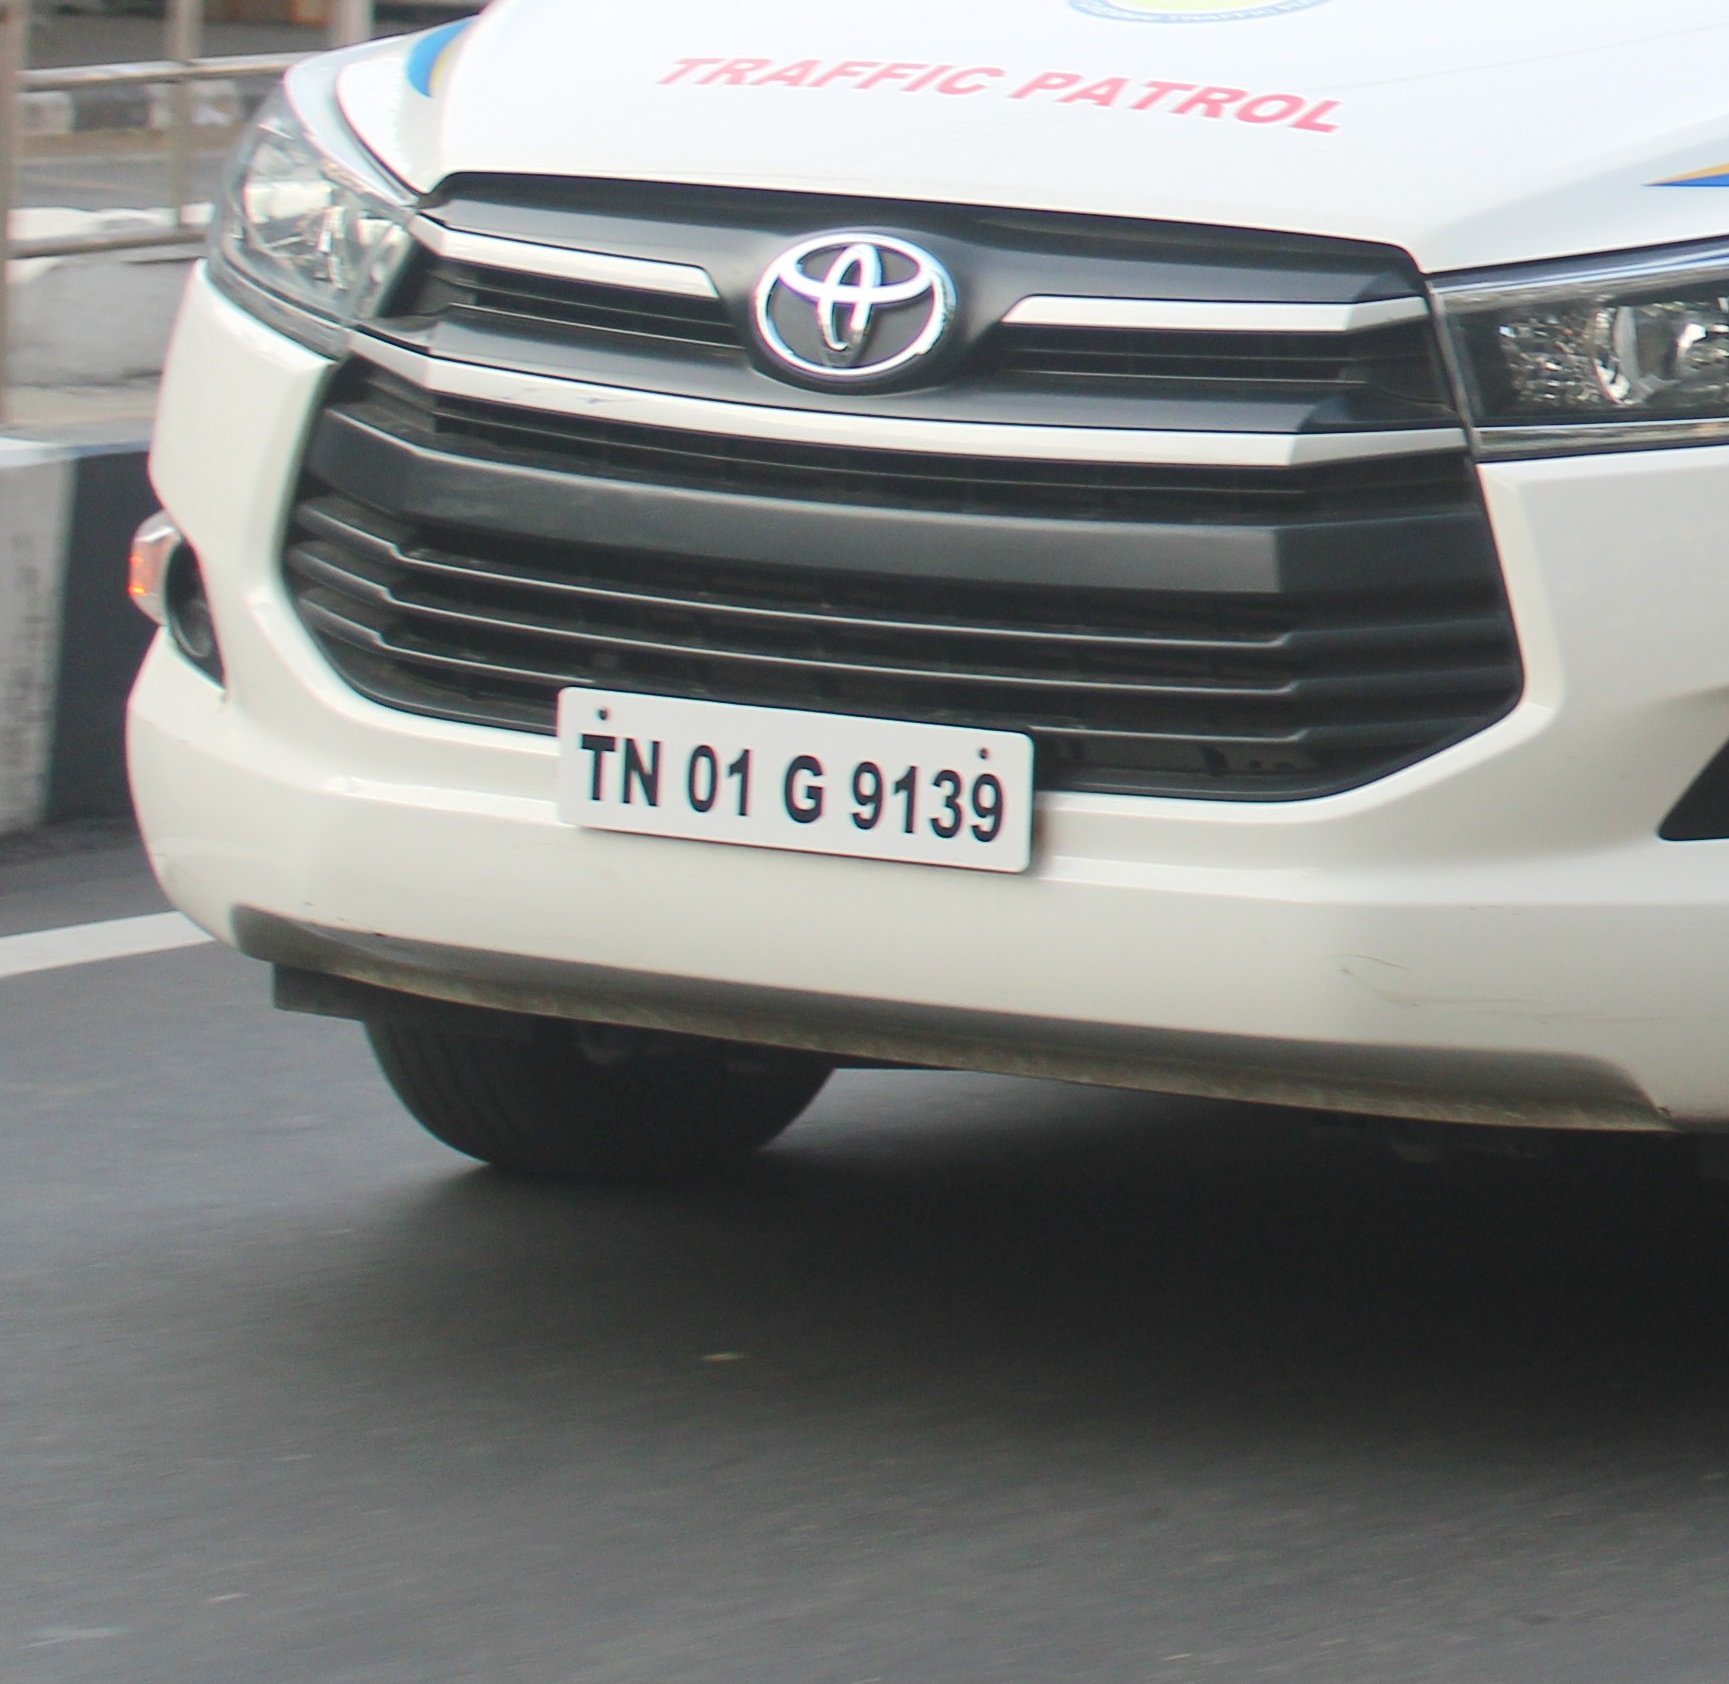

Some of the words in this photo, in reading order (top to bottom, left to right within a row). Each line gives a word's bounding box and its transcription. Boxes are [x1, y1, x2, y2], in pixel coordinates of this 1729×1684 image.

[657, 57, 1007, 96] TRAFFIC
[1007, 70, 1343, 134] PATROL
[579, 733, 662, 807] TN
[688, 745, 753, 817] 01
[784, 755, 825, 823] G
[851, 761, 1004, 843] 9139
